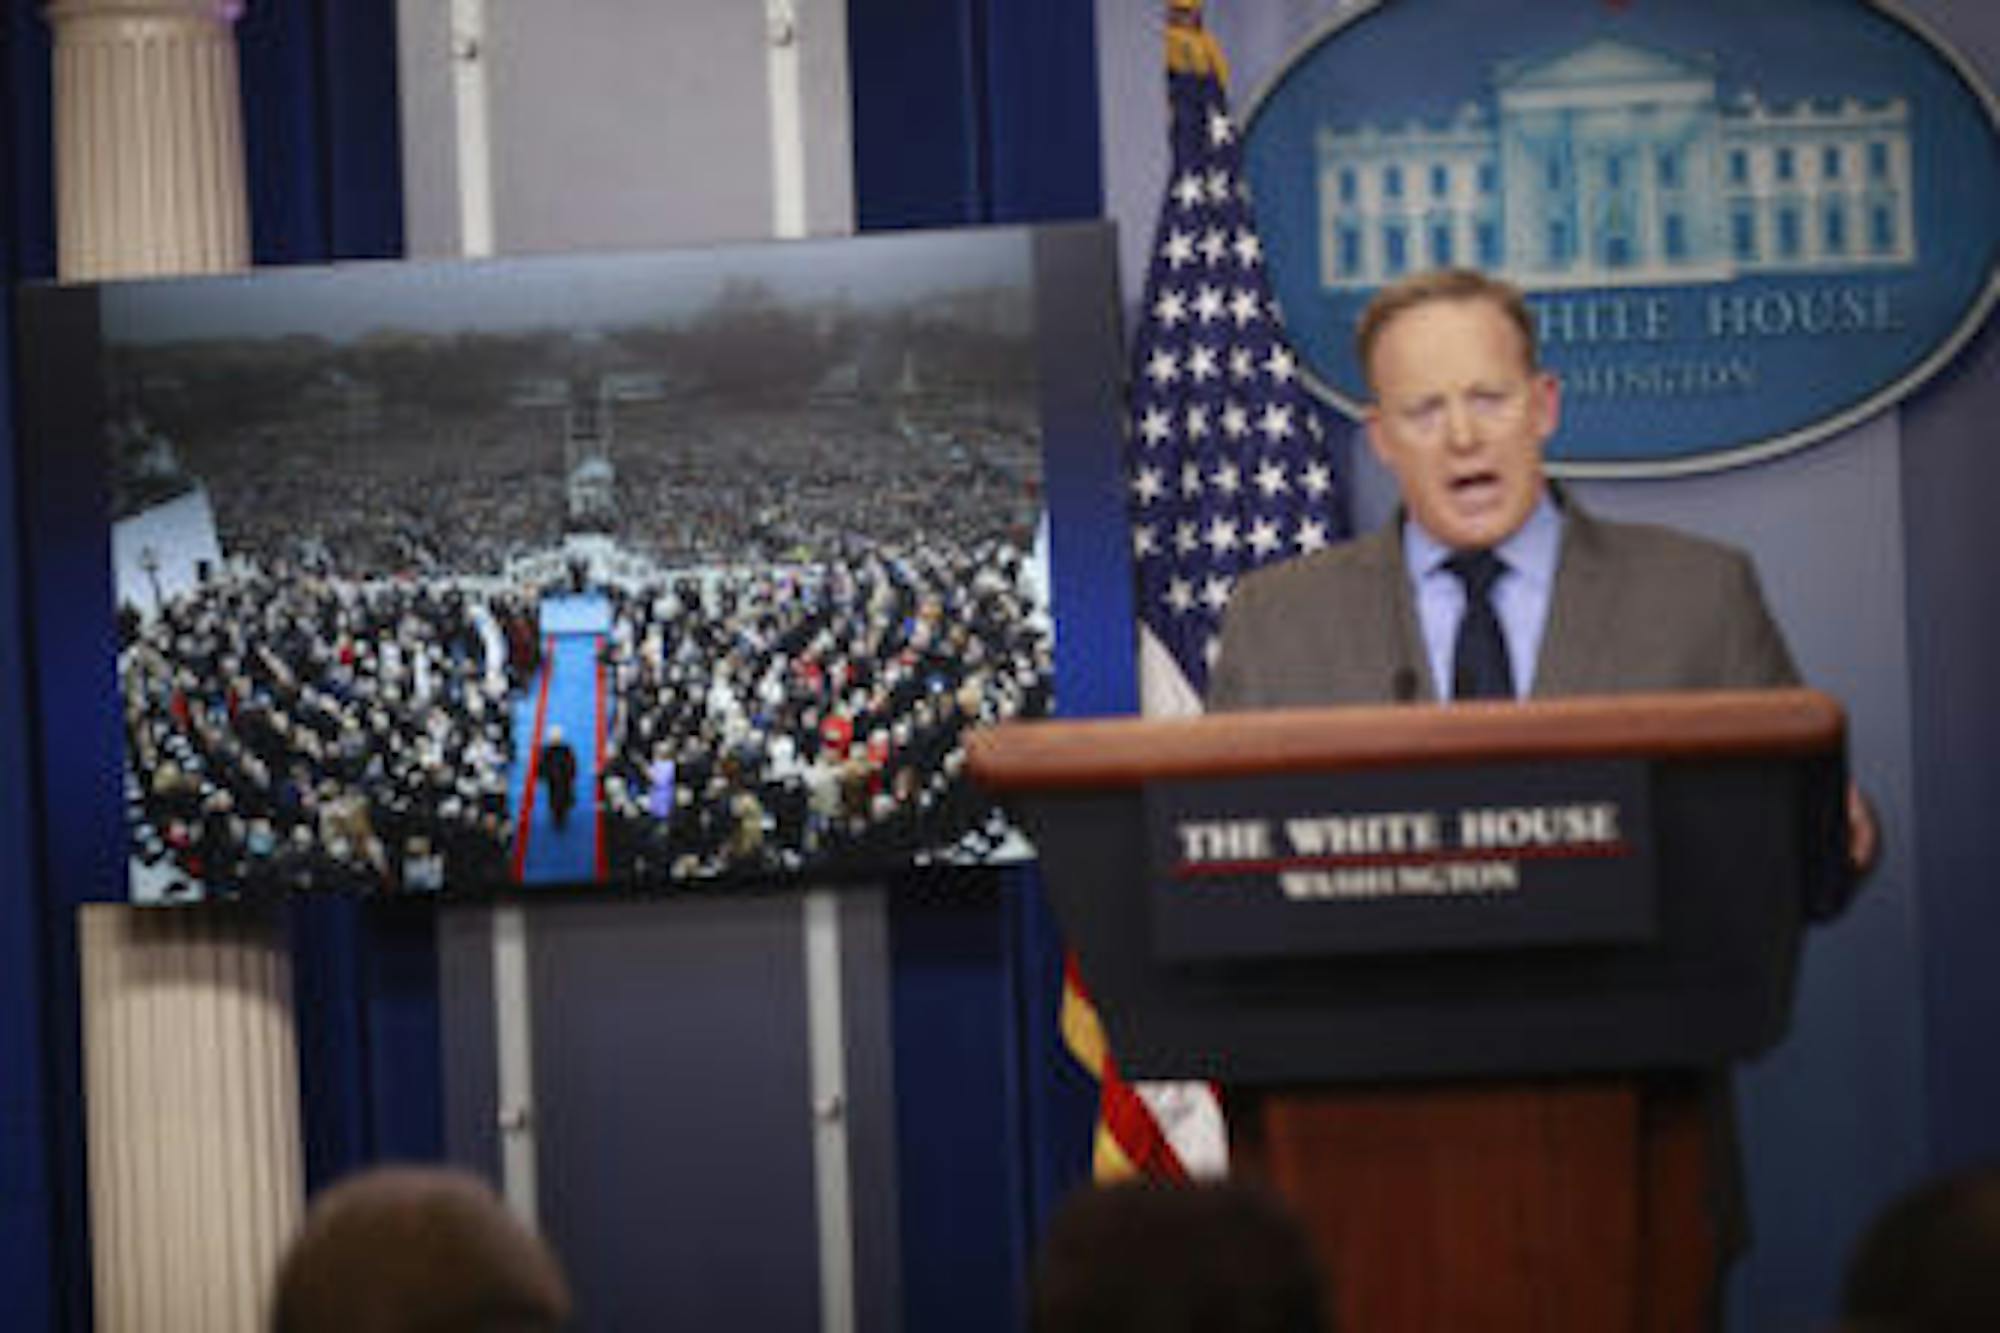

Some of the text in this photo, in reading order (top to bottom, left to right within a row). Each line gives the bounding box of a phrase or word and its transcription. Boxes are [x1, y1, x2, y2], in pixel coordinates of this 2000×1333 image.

[1534, 288, 1902, 341] HITE HOUSE
[1179, 804, 1618, 861] THE WHITE HOUSE
[1280, 862, 1519, 899] WASHINGTON
